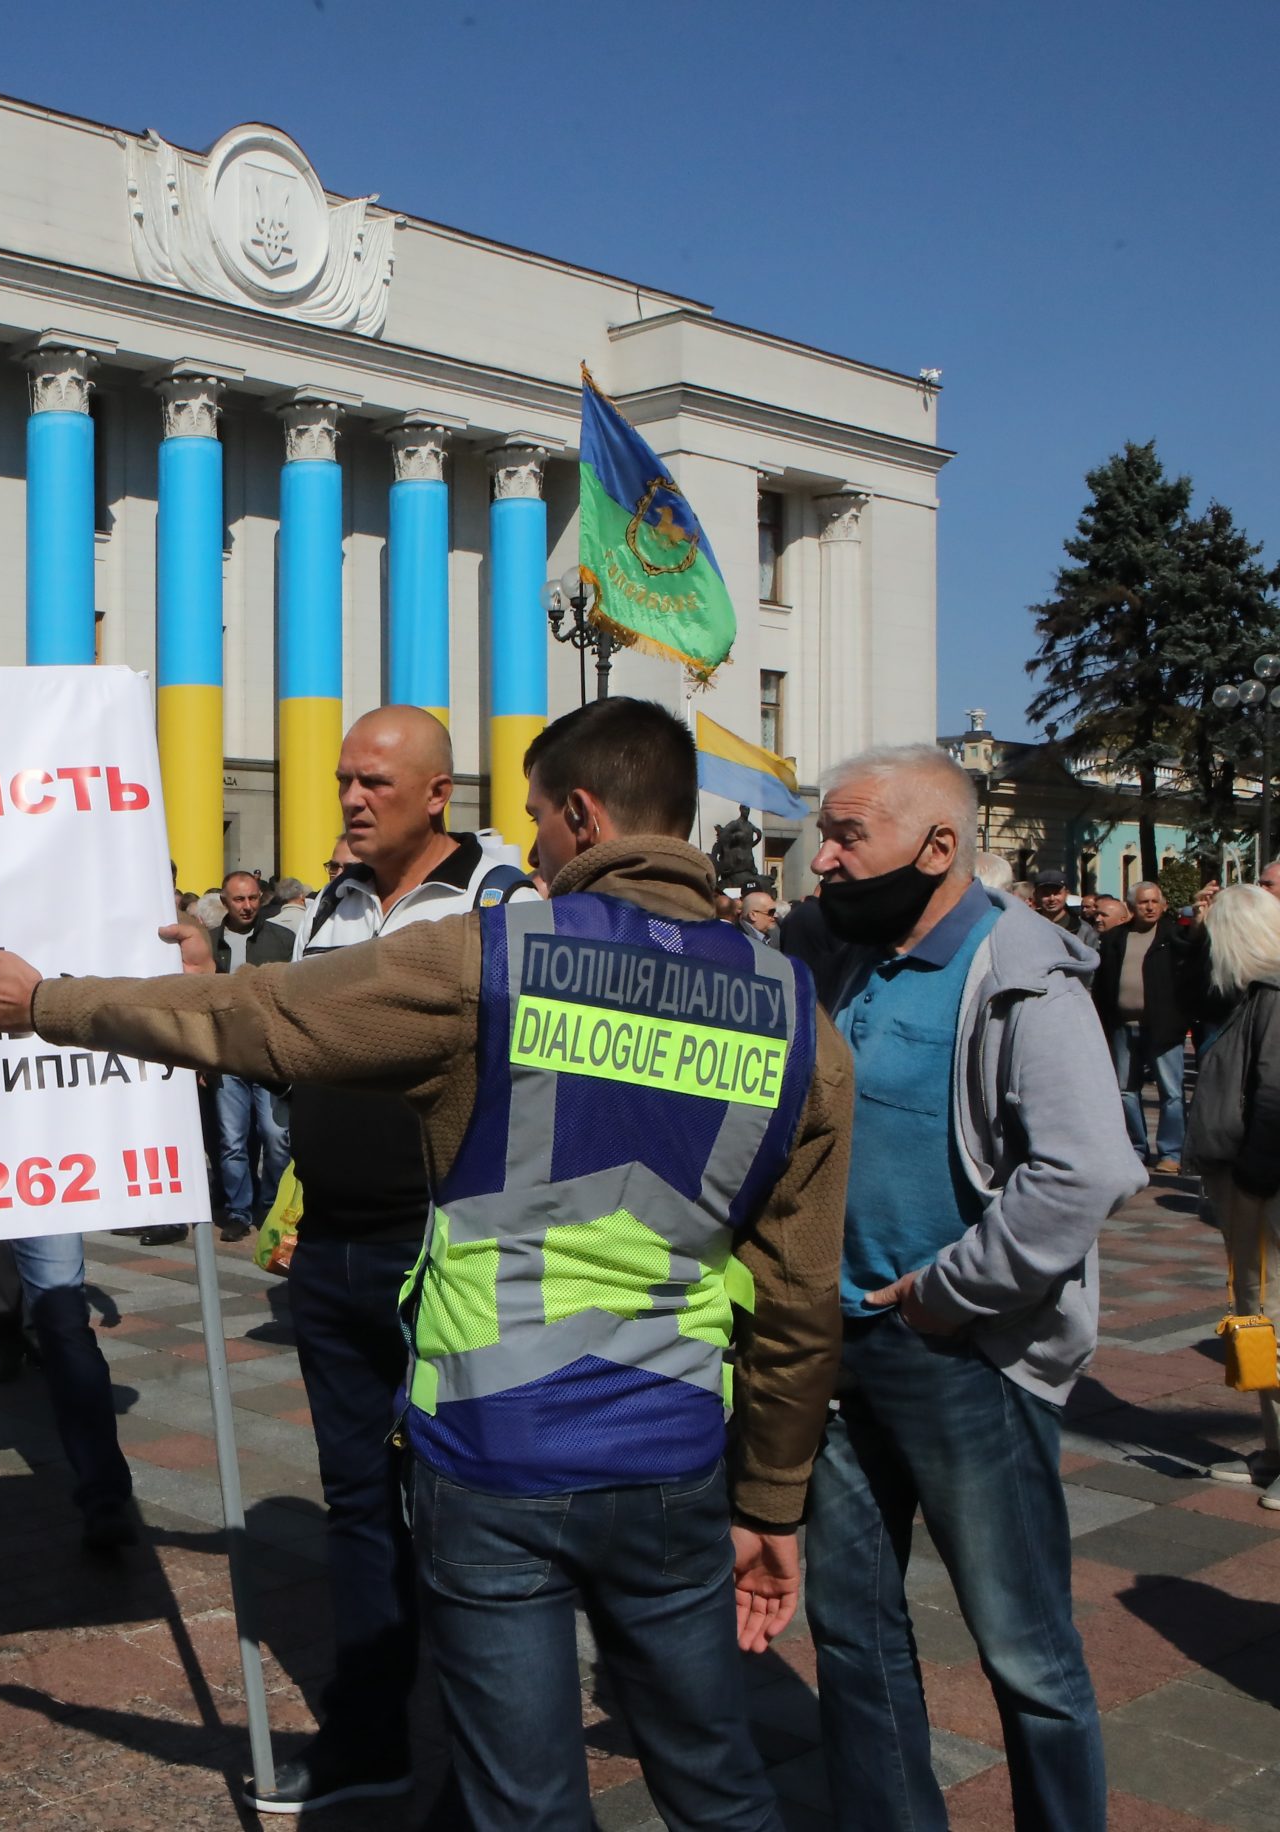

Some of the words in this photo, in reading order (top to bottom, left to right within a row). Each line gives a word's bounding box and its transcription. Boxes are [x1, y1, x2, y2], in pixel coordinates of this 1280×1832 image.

[526, 941, 656, 1007] ПОЛІЦІЯ
[657, 962, 782, 1030] ДІАЛОГУ
[517, 1007, 671, 1078] DIALOGUE
[674, 1034, 781, 1099] POLICE
[122, 1146, 184, 1197] !!!
